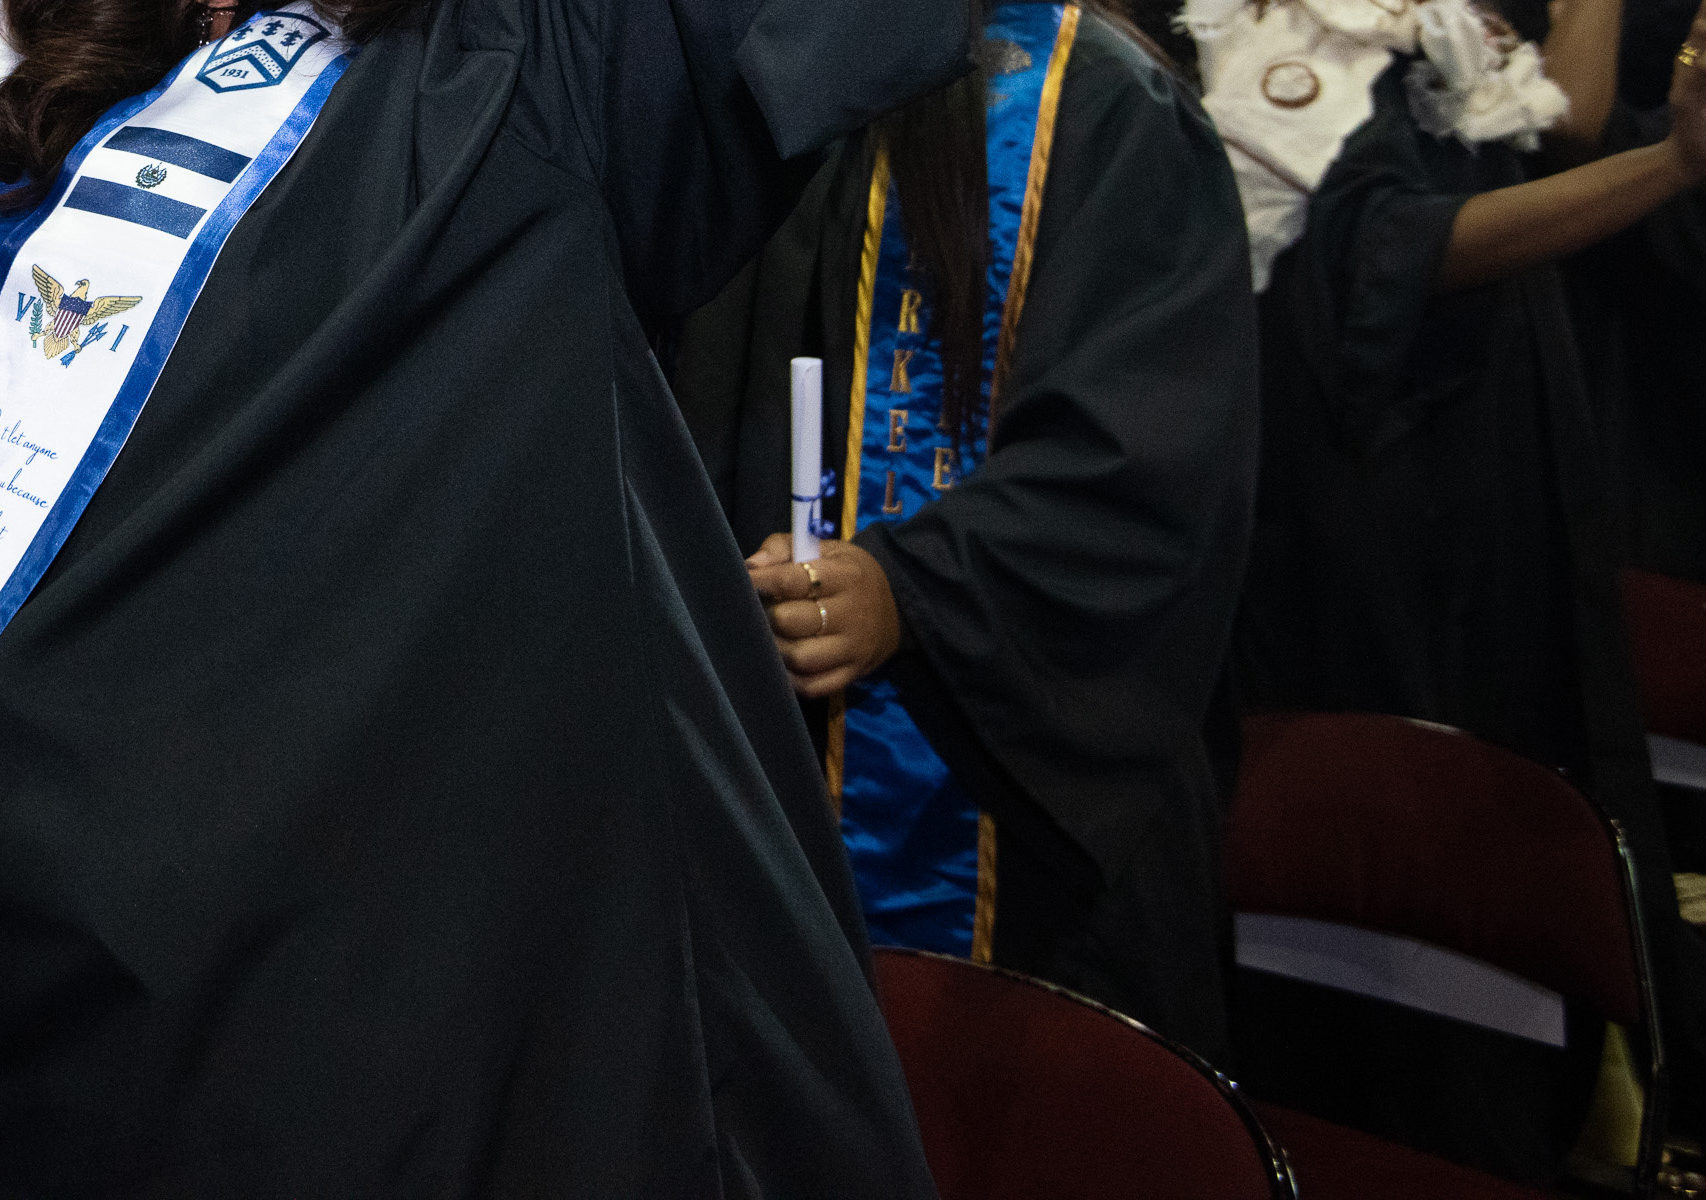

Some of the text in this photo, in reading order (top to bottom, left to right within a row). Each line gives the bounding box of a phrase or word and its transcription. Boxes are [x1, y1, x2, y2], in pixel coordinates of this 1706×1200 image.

[220, 68, 250, 79] 1931
[15, 291, 130, 352] V I
[7, 419, 26, 445] let
[22, 440, 59, 466] anyone
[6, 467, 49, 509] because
